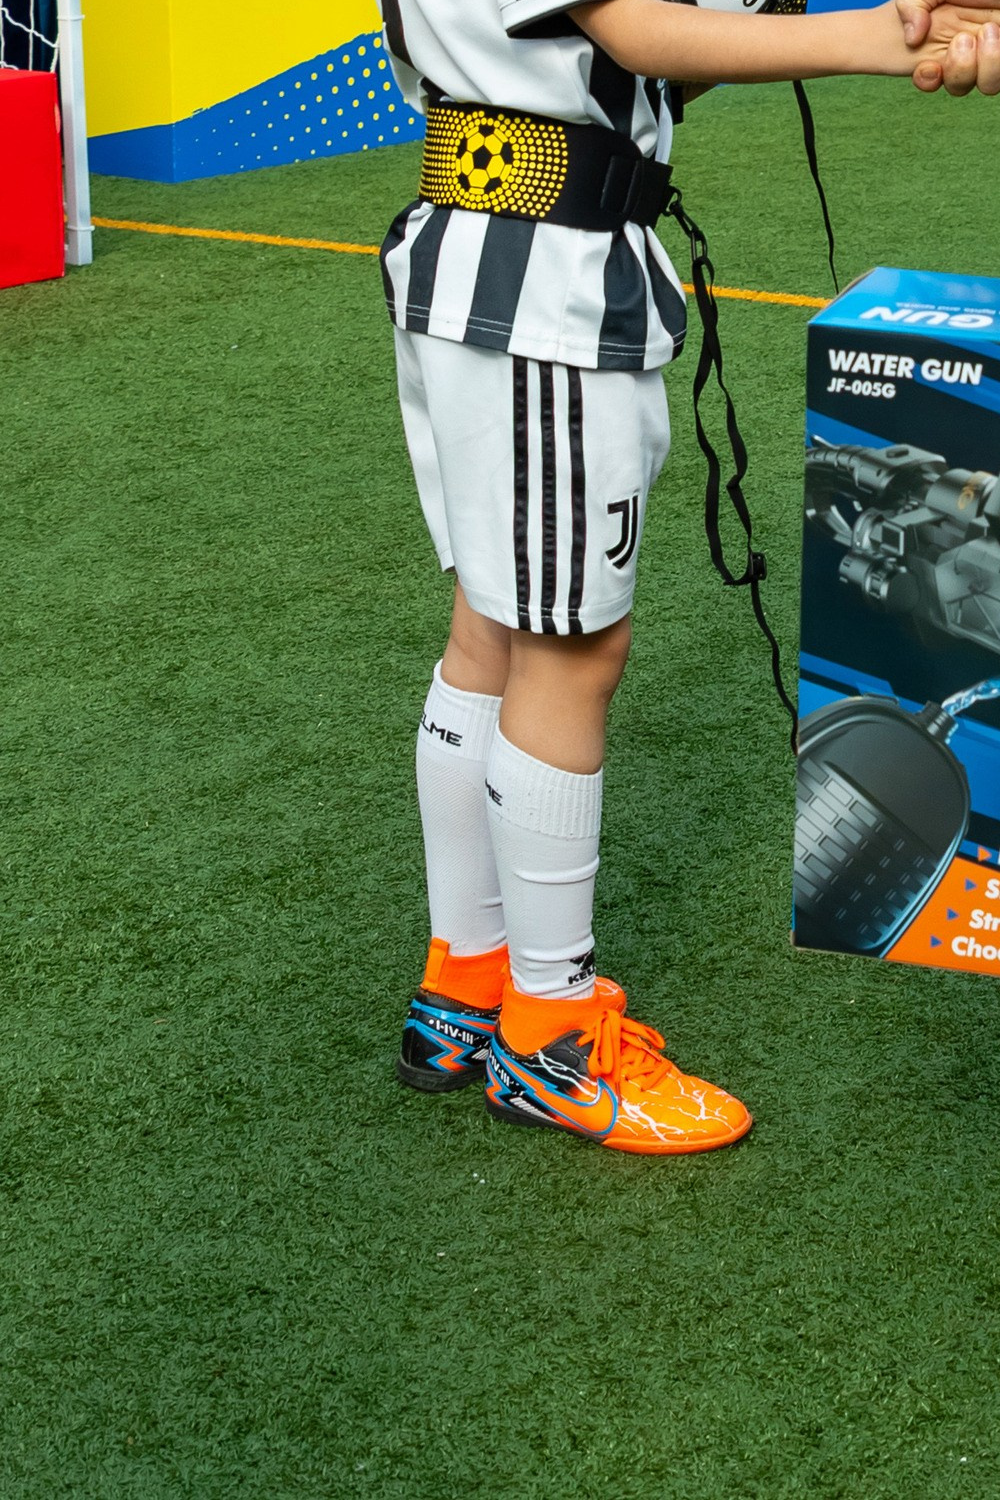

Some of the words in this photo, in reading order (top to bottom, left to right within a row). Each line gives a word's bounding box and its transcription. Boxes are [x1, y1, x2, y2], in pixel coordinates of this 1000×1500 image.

[859, 305, 994, 329] GUN
[828, 349, 914, 380] WATER
[921, 358, 983, 386] GUN
[826, 376, 897, 399] JF-005G
